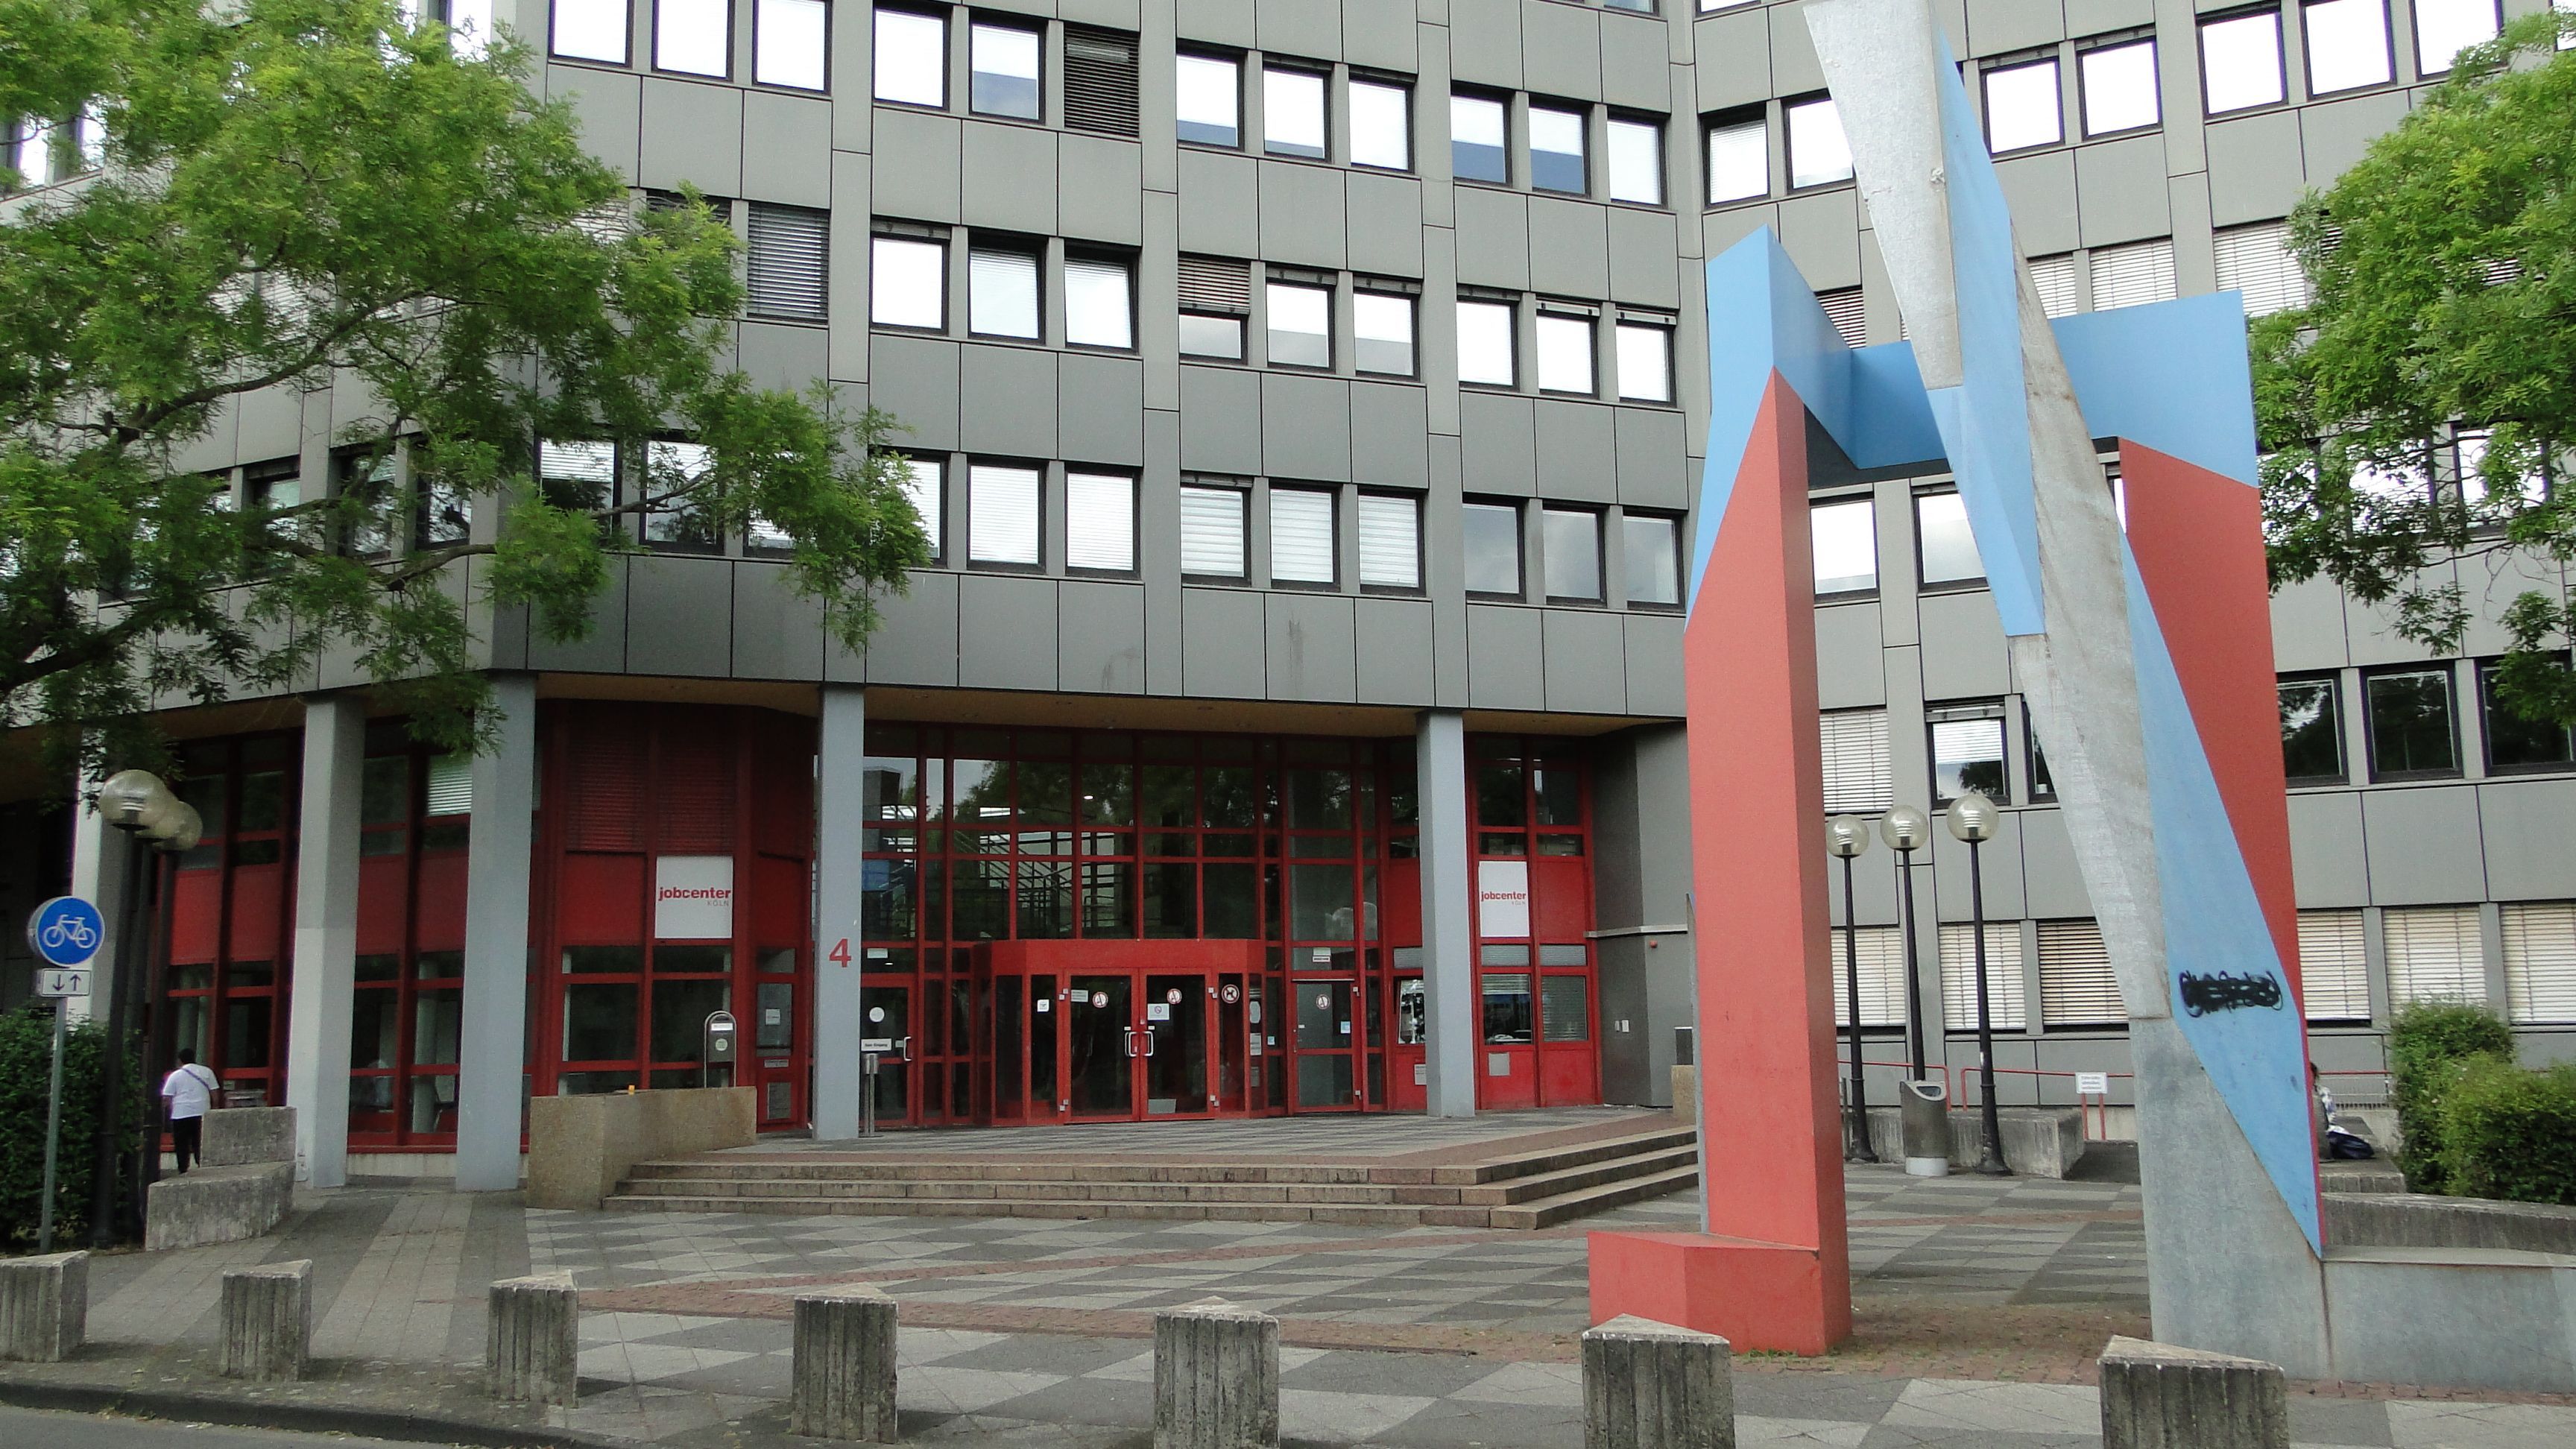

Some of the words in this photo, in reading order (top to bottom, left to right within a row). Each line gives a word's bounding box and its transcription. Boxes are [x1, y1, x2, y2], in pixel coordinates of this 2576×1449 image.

[658, 886, 731, 901] jobcenter
[1481, 891, 1527, 902] jobcenter
[707, 899, 730, 907] KÖLN
[829, 938, 852, 967] 4
